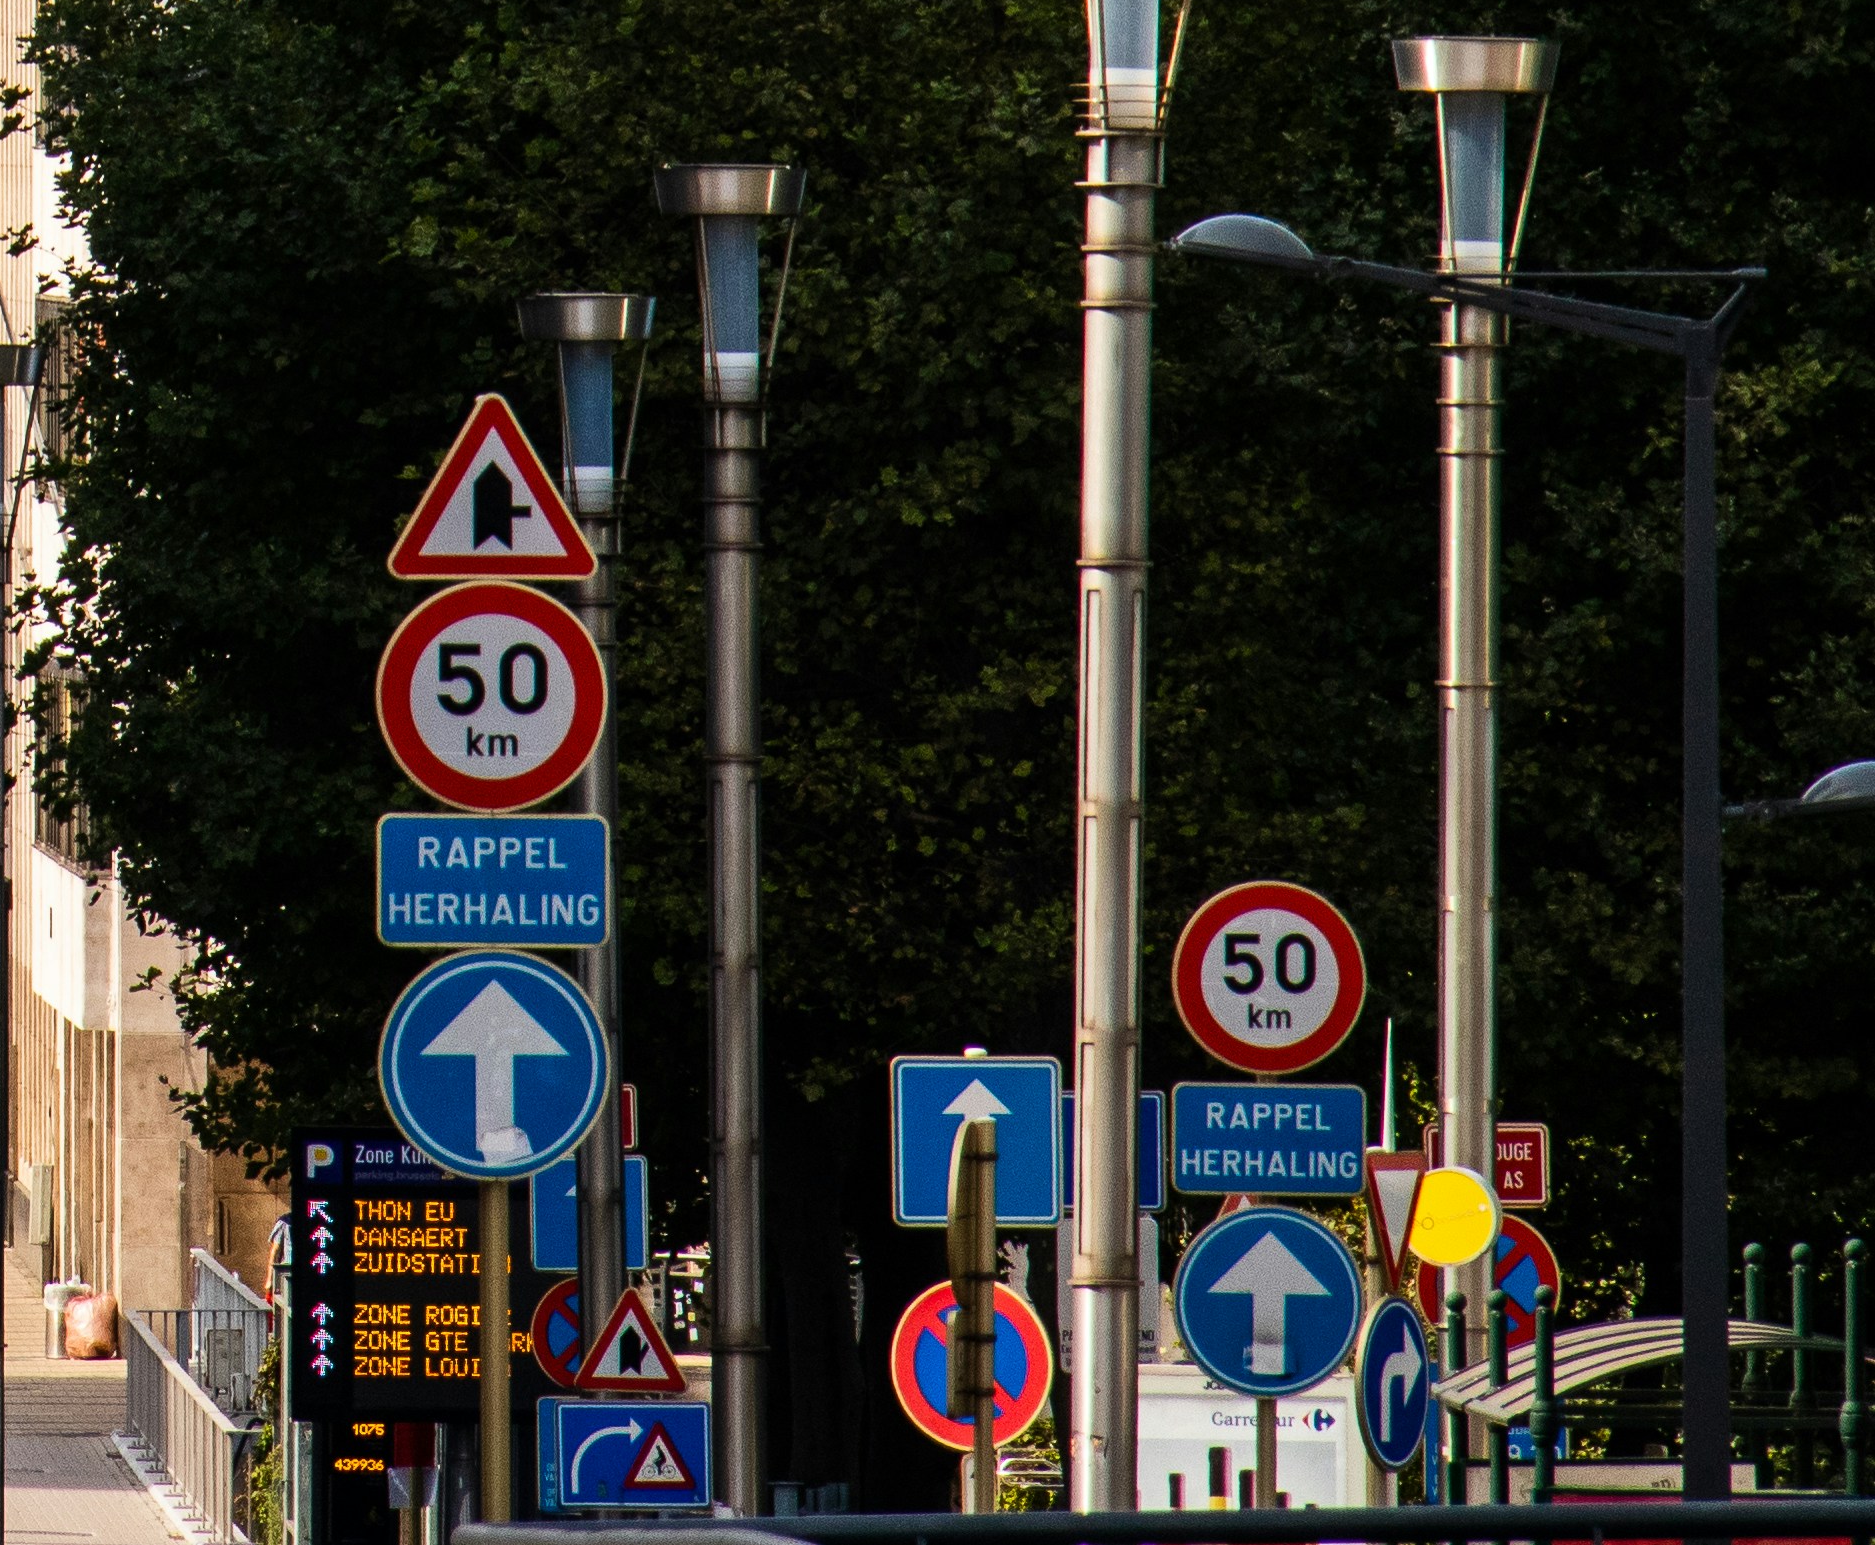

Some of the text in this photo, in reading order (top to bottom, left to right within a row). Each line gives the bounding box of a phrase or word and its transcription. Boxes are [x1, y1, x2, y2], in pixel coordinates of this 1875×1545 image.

[436, 642, 549, 716] 50
[466, 727, 519, 758] km
[418, 837, 568, 870] RAPPEL
[388, 894, 600, 927] HERHALING
[1222, 932, 1317, 995] 50
[1247, 1003, 1292, 1030] km
[1205, 1102, 1331, 1131] RAPPEL
[355, 1144, 394, 1164] Zone
[1181, 1148, 1358, 1180] HERHALING
[1503, 1170, 1524, 1189] AS
[354, 1200, 454, 1222] THON EU
[354, 1226, 468, 1248] DANSAERT
[354, 1253, 511, 1274] ZUIDSTATI
[354, 1304, 512, 1326] ZONE ROGI
[354, 1330, 411, 1351] ZONE
[425, 1331, 468, 1352] GTE
[354, 1356, 512, 1377] ZONE LOUI
[352, 1423, 385, 1436] 1075
[1211, 1411, 1296, 1428] Carreur
[334, 1458, 385, 1471] 439936
